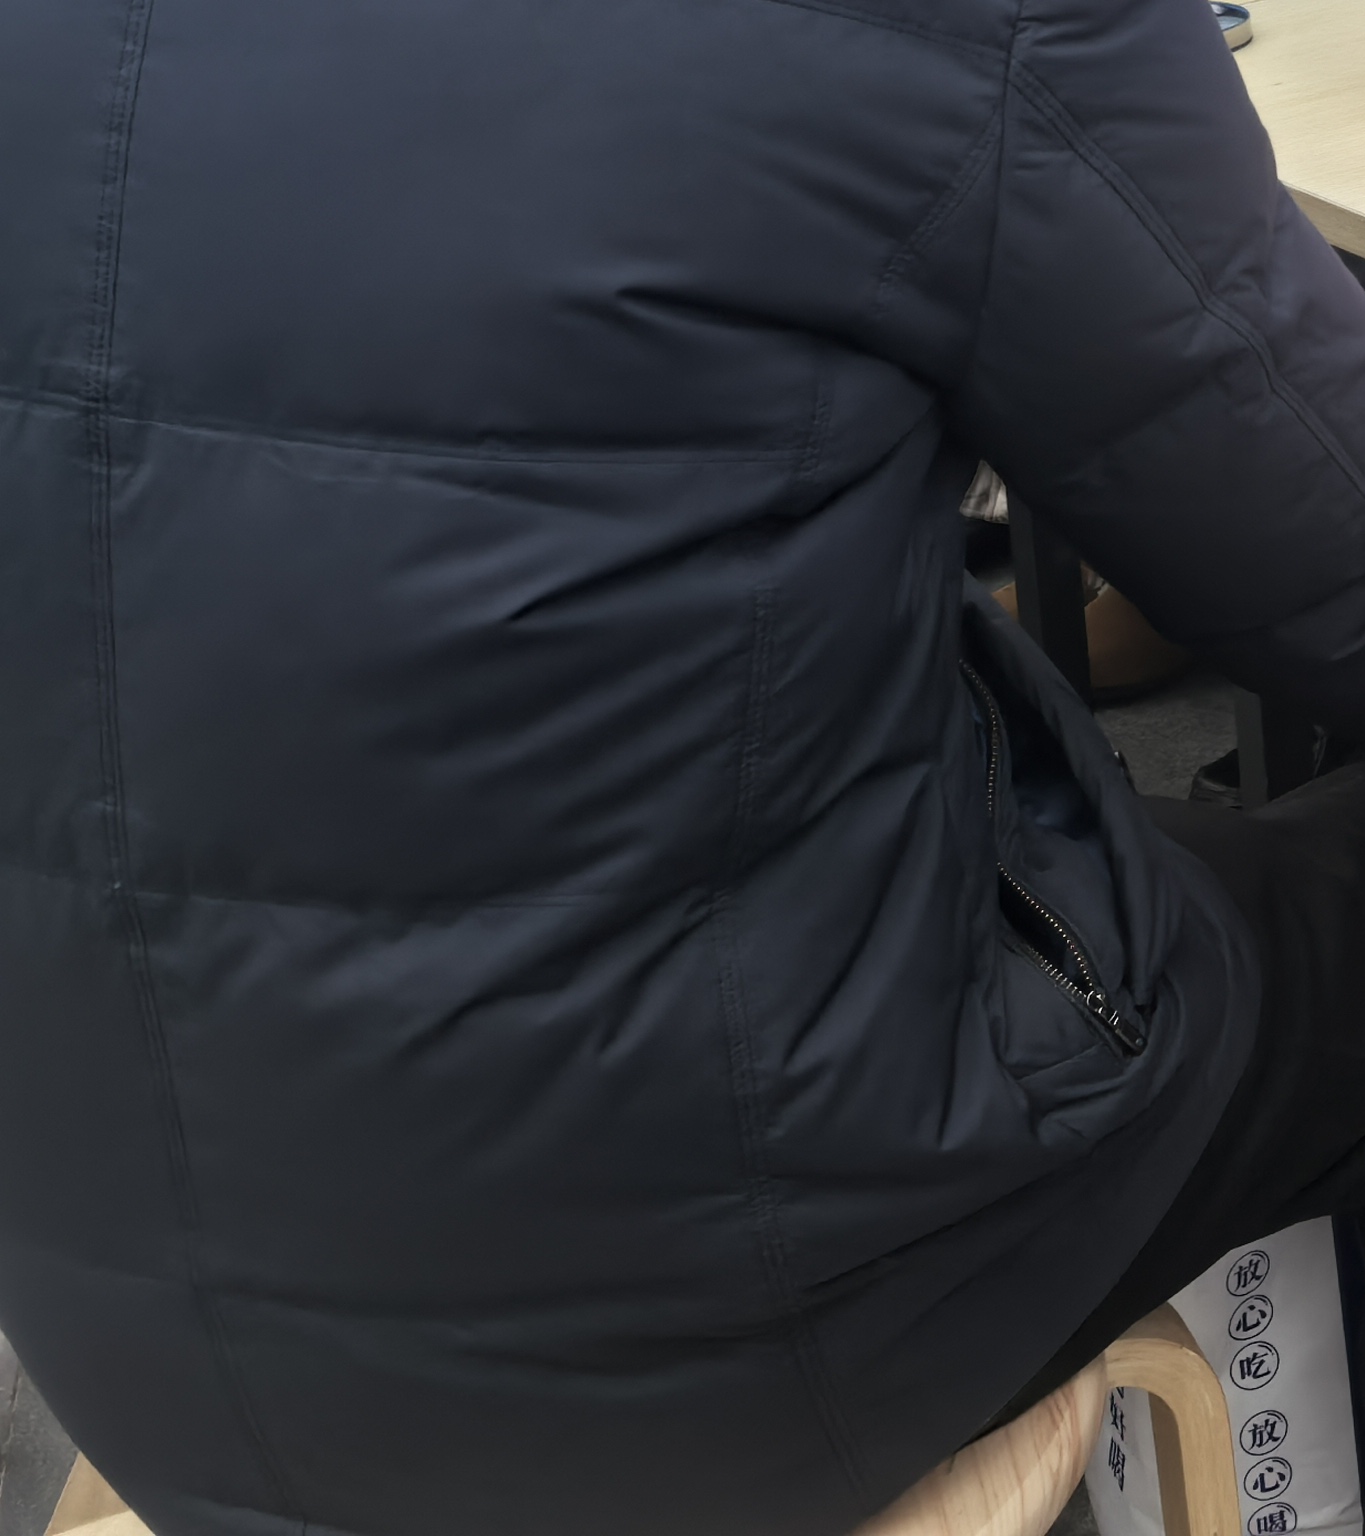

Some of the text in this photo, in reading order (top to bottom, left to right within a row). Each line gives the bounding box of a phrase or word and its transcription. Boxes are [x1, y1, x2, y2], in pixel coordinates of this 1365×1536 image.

[1230, 1254, 1274, 1384] 放心吃
[1245, 1416, 1290, 1534] 放心喝
